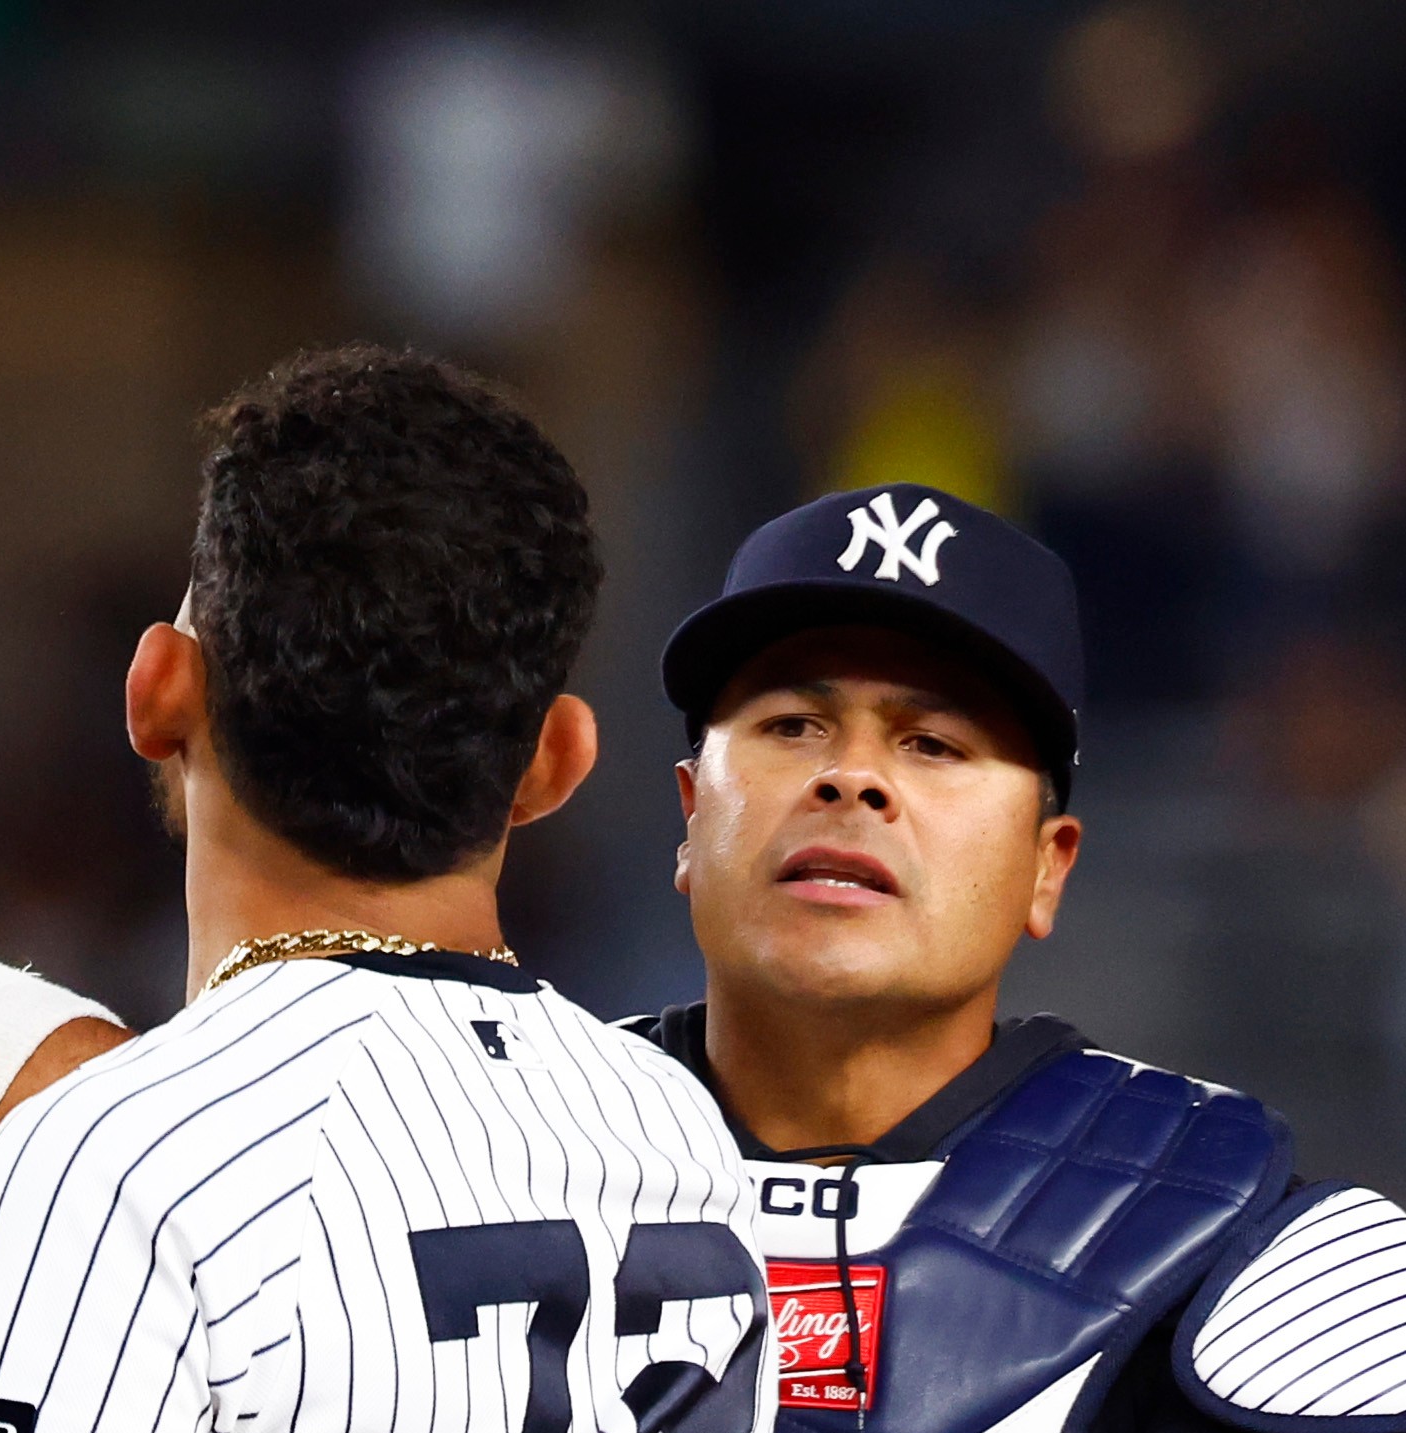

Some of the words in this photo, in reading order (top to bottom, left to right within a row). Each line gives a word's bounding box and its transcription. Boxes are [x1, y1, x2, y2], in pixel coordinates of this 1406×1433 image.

[837, 492, 960, 587] NY
[749, 1176, 860, 1221] CO
[791, 1383, 821, 1399] Est.
[823, 1385, 858, 1401] 1887
